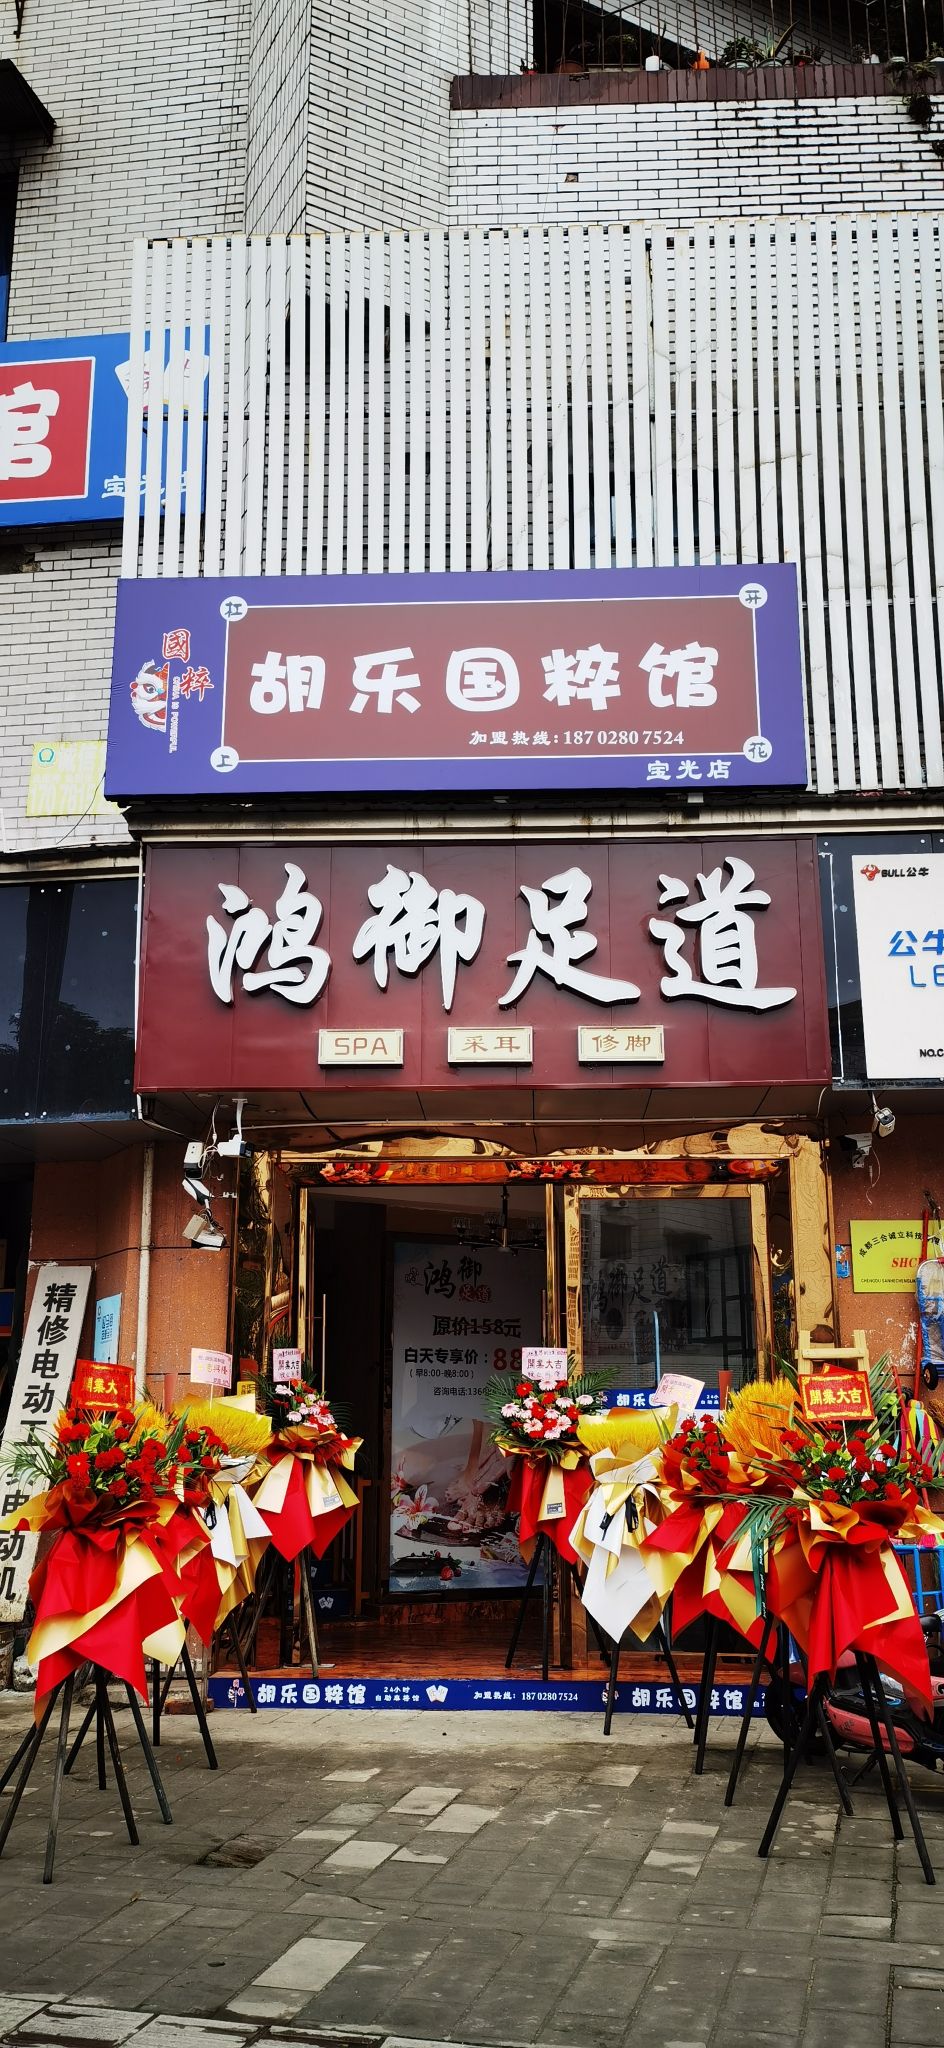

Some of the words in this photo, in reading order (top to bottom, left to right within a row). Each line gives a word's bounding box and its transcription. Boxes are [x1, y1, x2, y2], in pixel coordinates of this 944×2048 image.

[744, 589, 762, 604] 开
[249, 641, 719, 714] 胡乐国粹馆
[748, 742, 768, 760] 花
[216, 754, 233, 768] 上
[646, 759, 733, 781] 宝光店
[206, 856, 798, 1011] 鸿御足道
[334, 1037, 388, 1056] SPA
[461, 1035, 521, 1053] 采耳
[592, 1034, 651, 1053] 修脚
[432, 1315, 522, 1339] 原价158元
[809, 1387, 862, 1406] 開業大吉
[257, 1683, 367, 1705] 胡乐国粹馆
